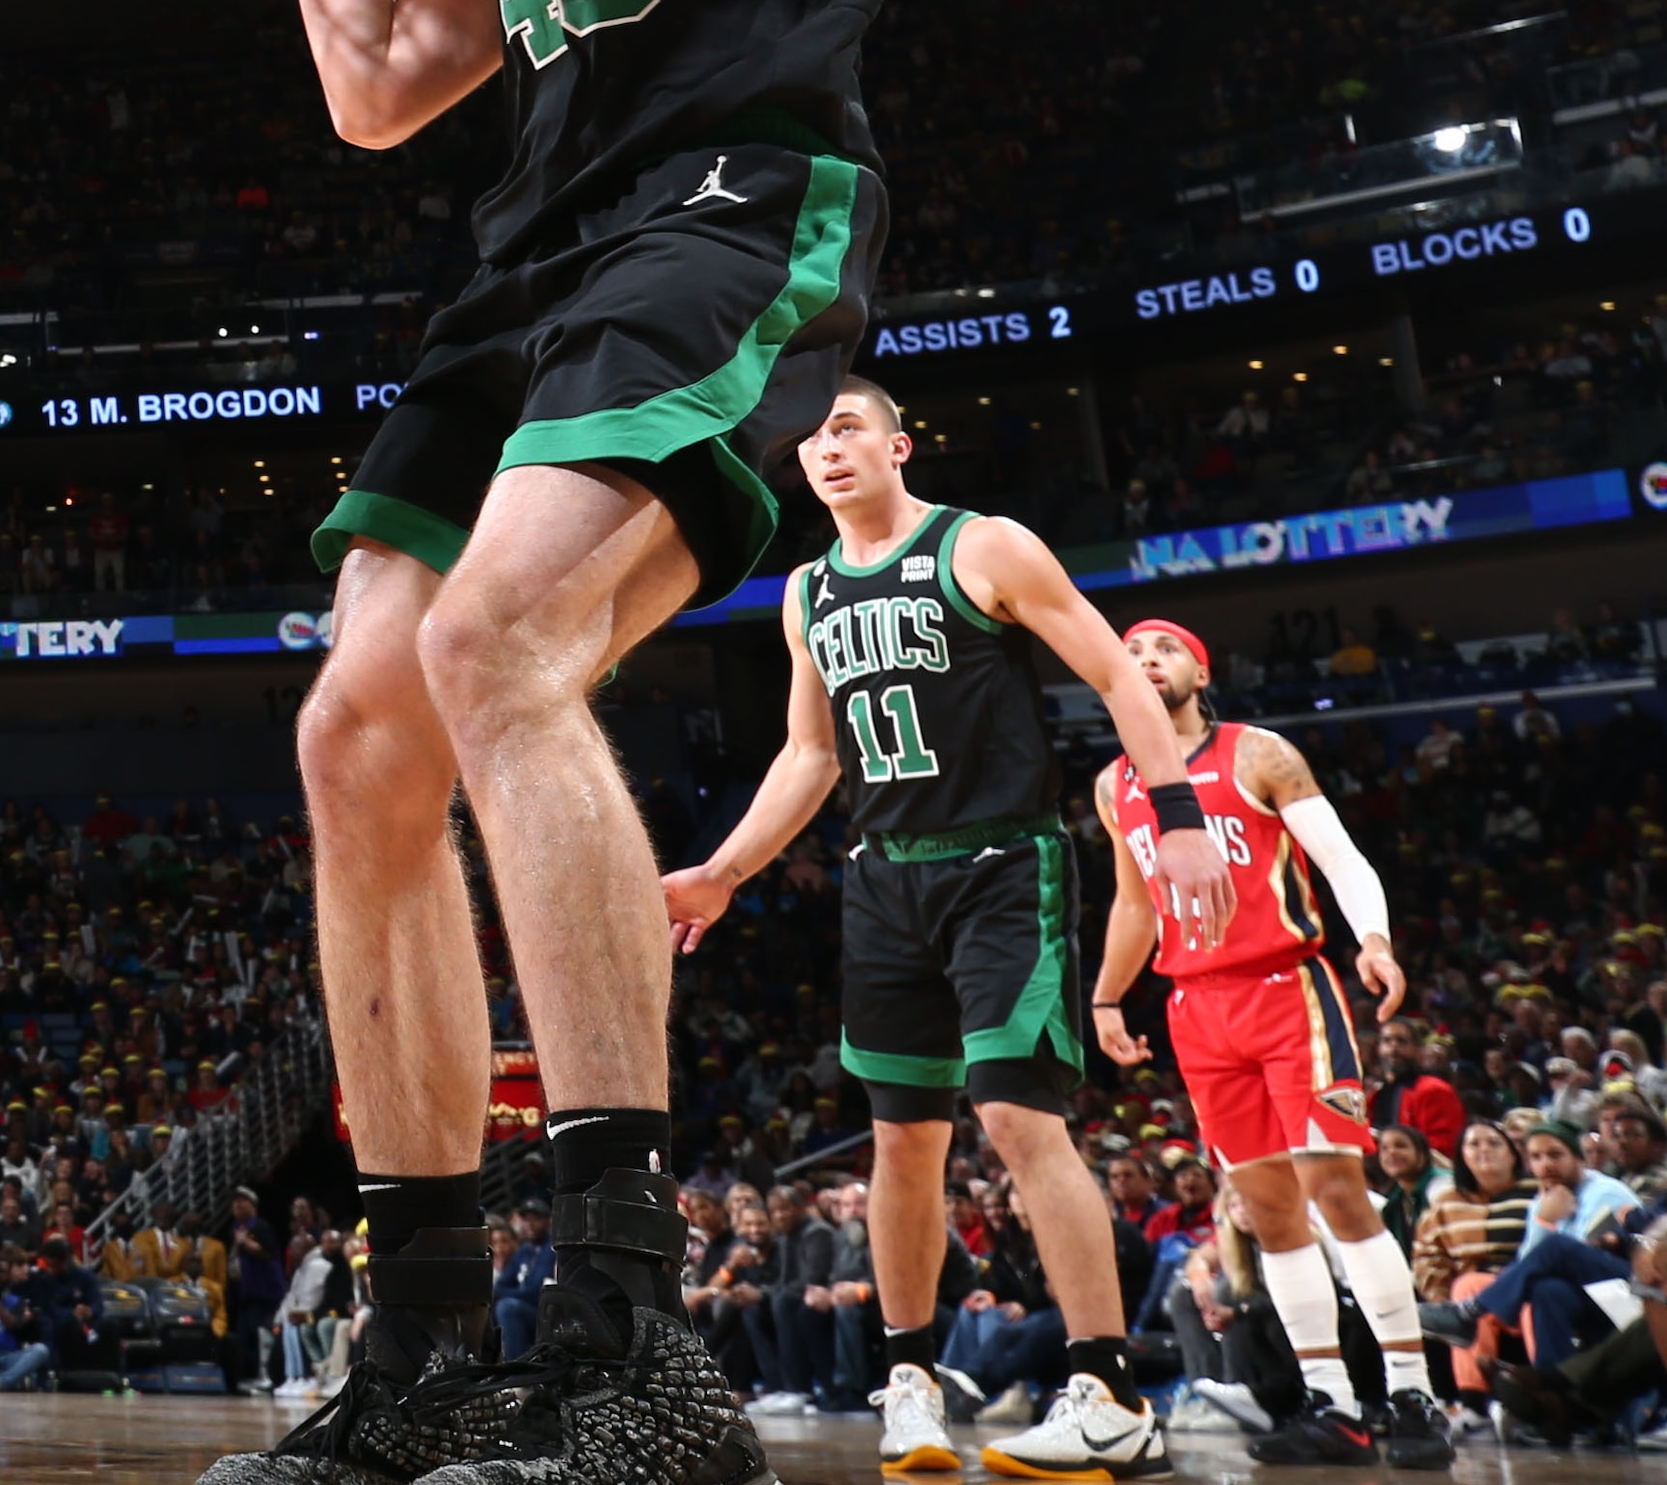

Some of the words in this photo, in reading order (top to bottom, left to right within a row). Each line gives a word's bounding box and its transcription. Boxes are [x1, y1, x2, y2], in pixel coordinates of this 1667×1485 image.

[874, 312, 1032, 359] ASSISTS
[1049, 306, 1071, 338] 2
[1136, 267, 1276, 319] STEALS
[1295, 258, 1320, 292] 0
[1372, 217, 1537, 276] BLOCKS
[1563, 207, 1592, 243] 0
[41, 398, 79, 427] 13
[90, 396, 128, 424] M.
[137, 385, 321, 422] BROGDON
[901, 555, 936, 572] VISTA
[901, 569, 936, 583] PRINT
[1130, 533, 1215, 582] NA
[1221, 496, 1453, 570] LOTTERY
[808, 595, 952, 698] CELTICS
[847, 683, 940, 784] 11
